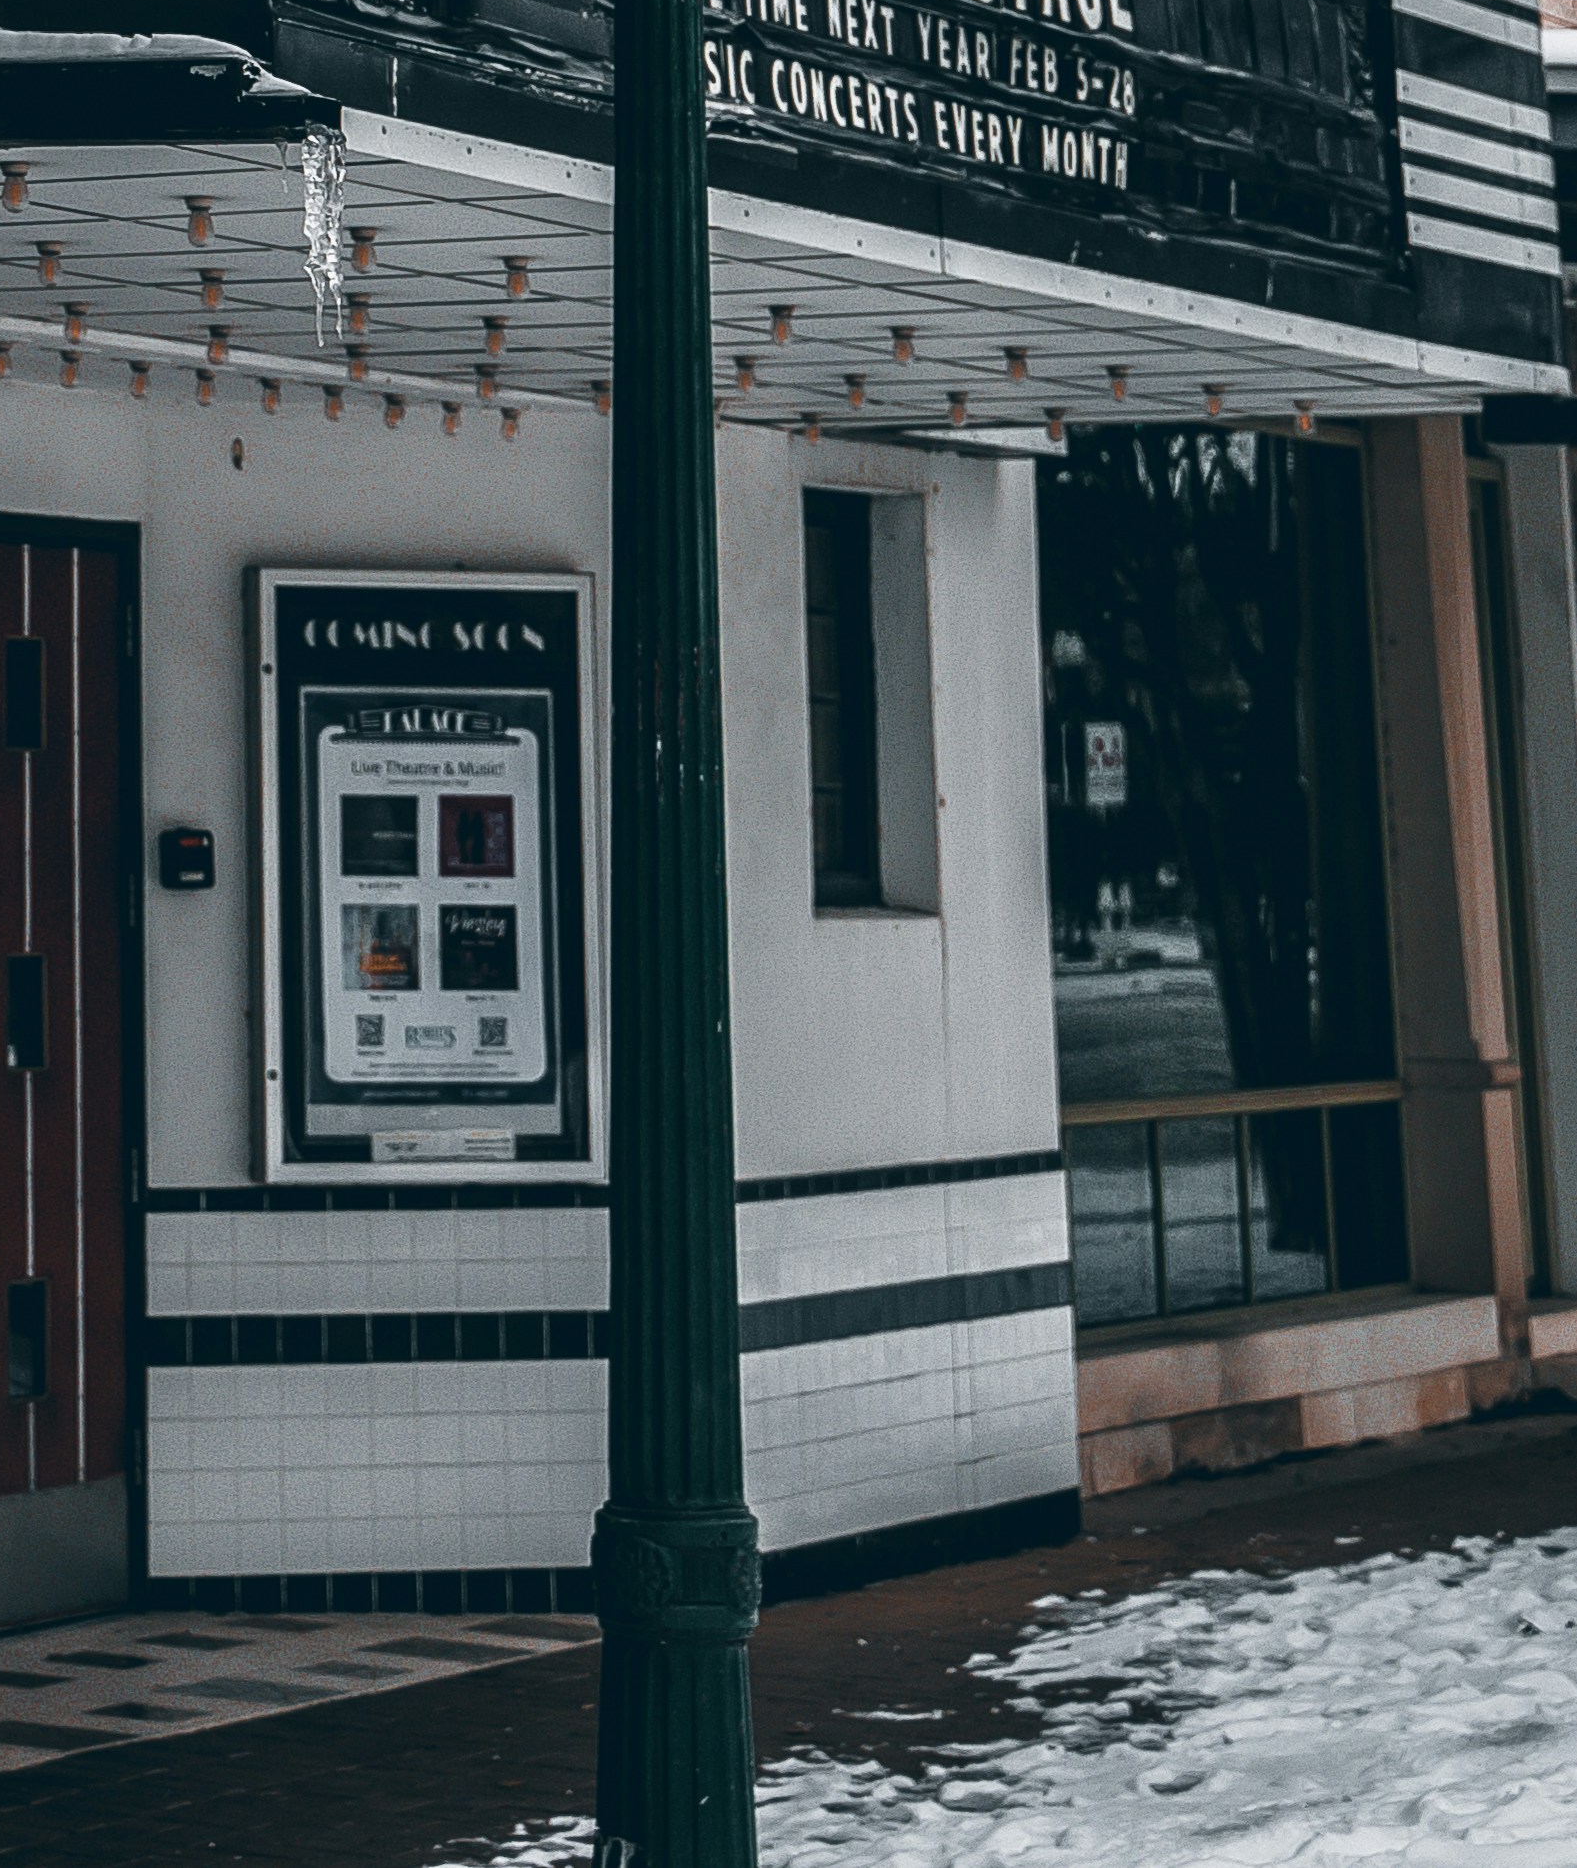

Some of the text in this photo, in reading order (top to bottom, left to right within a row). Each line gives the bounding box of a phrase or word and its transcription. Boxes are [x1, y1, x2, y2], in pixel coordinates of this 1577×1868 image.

[703, 40, 1129, 191] SIC CONCERTS EVERY MONTH
[918, 13, 991, 81] YEAR
[1009, 37, 1059, 94] FEB
[1076, 57, 1136, 116] 5-28
